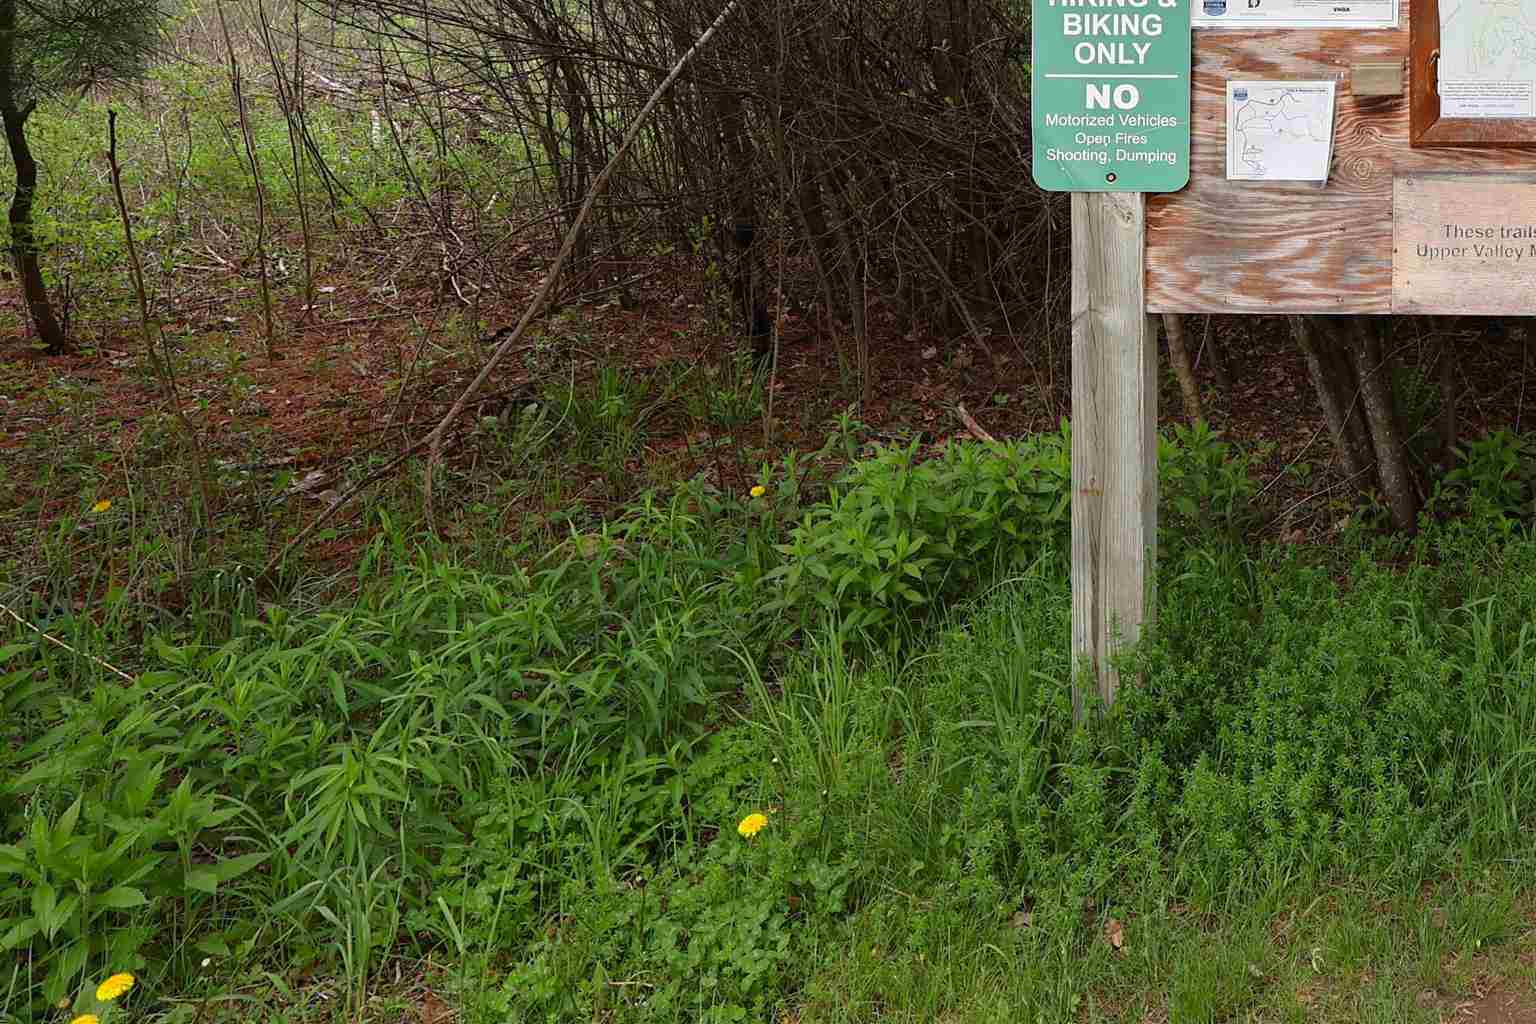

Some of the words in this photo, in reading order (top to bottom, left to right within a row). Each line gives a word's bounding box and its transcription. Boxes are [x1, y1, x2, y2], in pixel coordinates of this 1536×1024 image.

[1063, 13, 1163, 36] BIKING
[1074, 42, 1152, 65] ONLY
[1086, 83, 1140, 110] NO
[1045, 113, 1115, 127] Motorized
[1119, 113, 1177, 128] Vehicles
[1075, 132, 1111, 147] Open
[1115, 132, 1148, 145] Fires
[1046, 148, 1112, 164] Shooting,
[1116, 148, 1177, 164] Dumping
[1441, 224, 1493, 239] These
[1415, 245, 1467, 260] Upper
[1472, 244, 1524, 260] Valley
